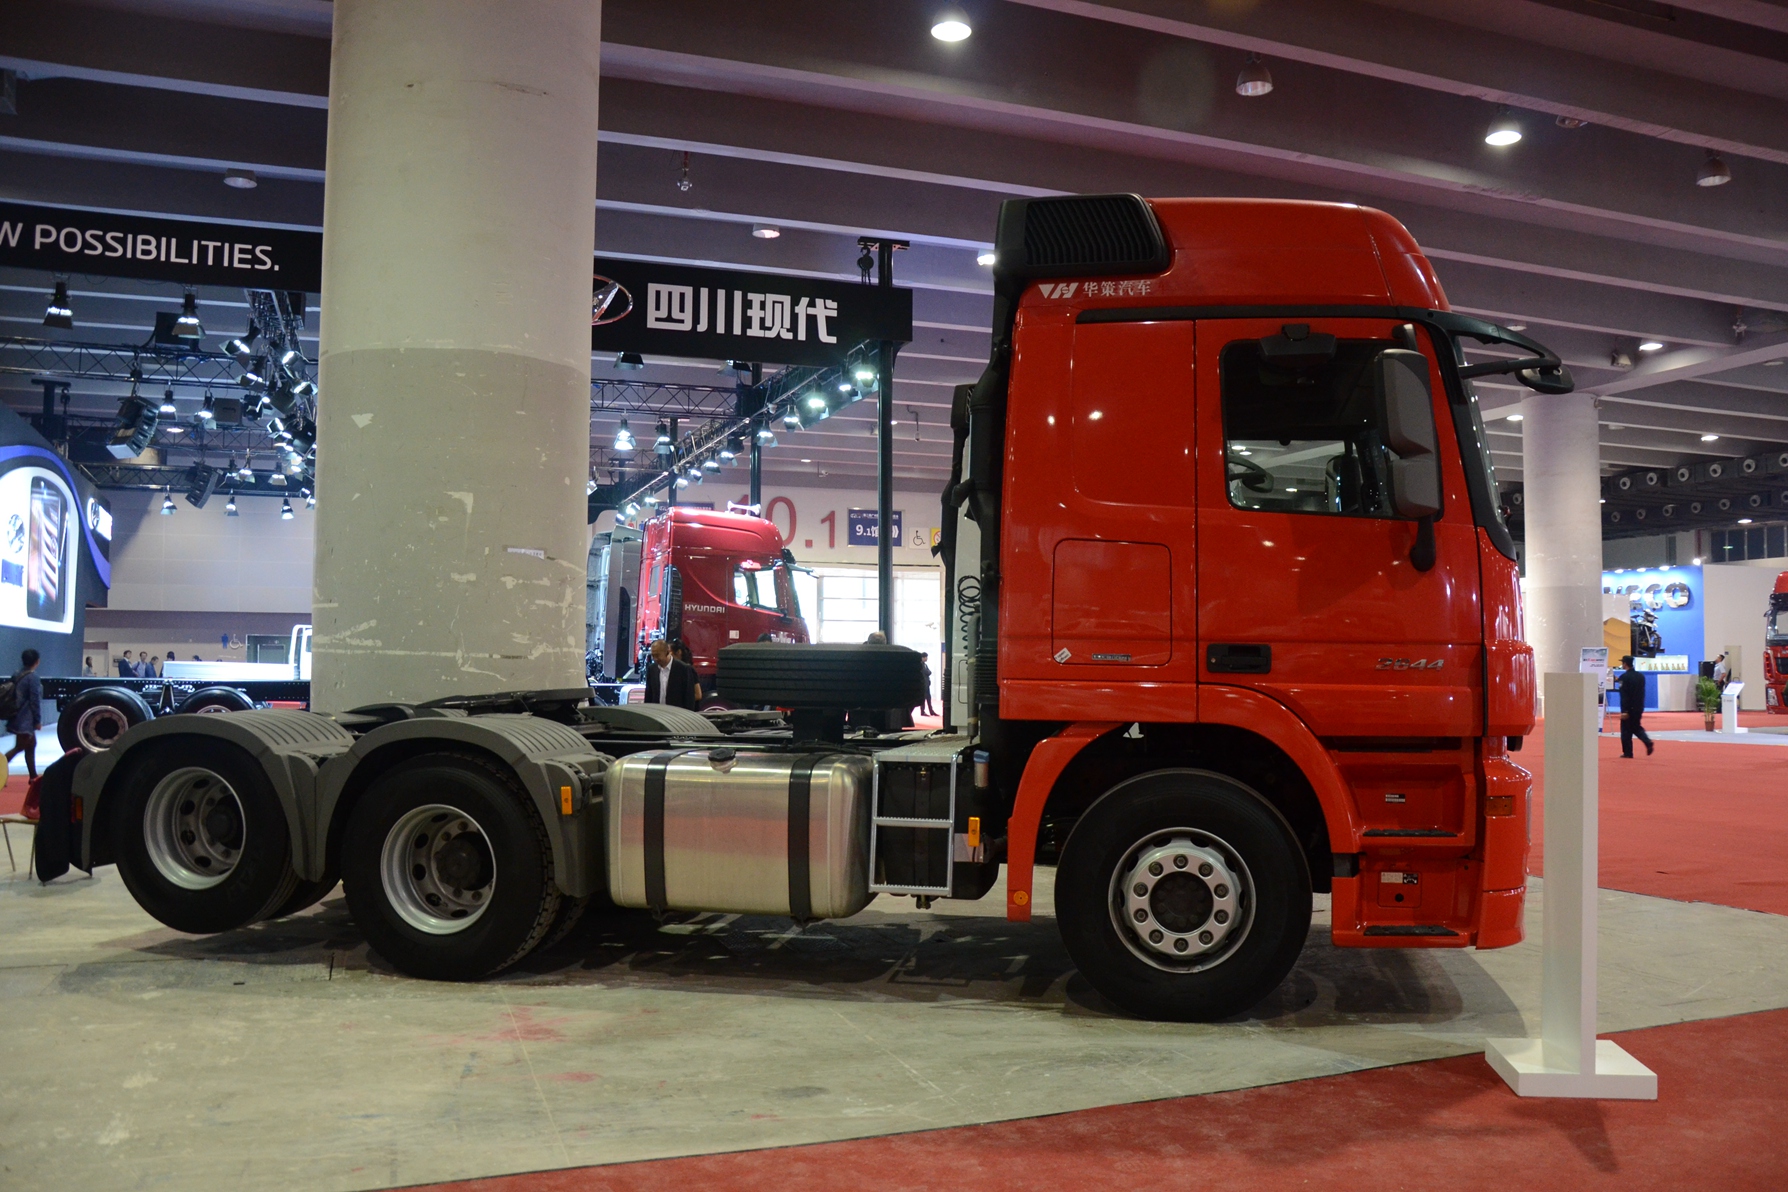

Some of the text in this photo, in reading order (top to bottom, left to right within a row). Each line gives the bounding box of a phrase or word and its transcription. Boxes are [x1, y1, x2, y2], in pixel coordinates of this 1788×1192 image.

[34, 224, 280, 271] POSSIBILITIES.
[1082, 280, 1151, 297] 华策汽车
[646, 282, 837, 344] 四川现代
[684, 604, 725, 614] HYUNDAI
